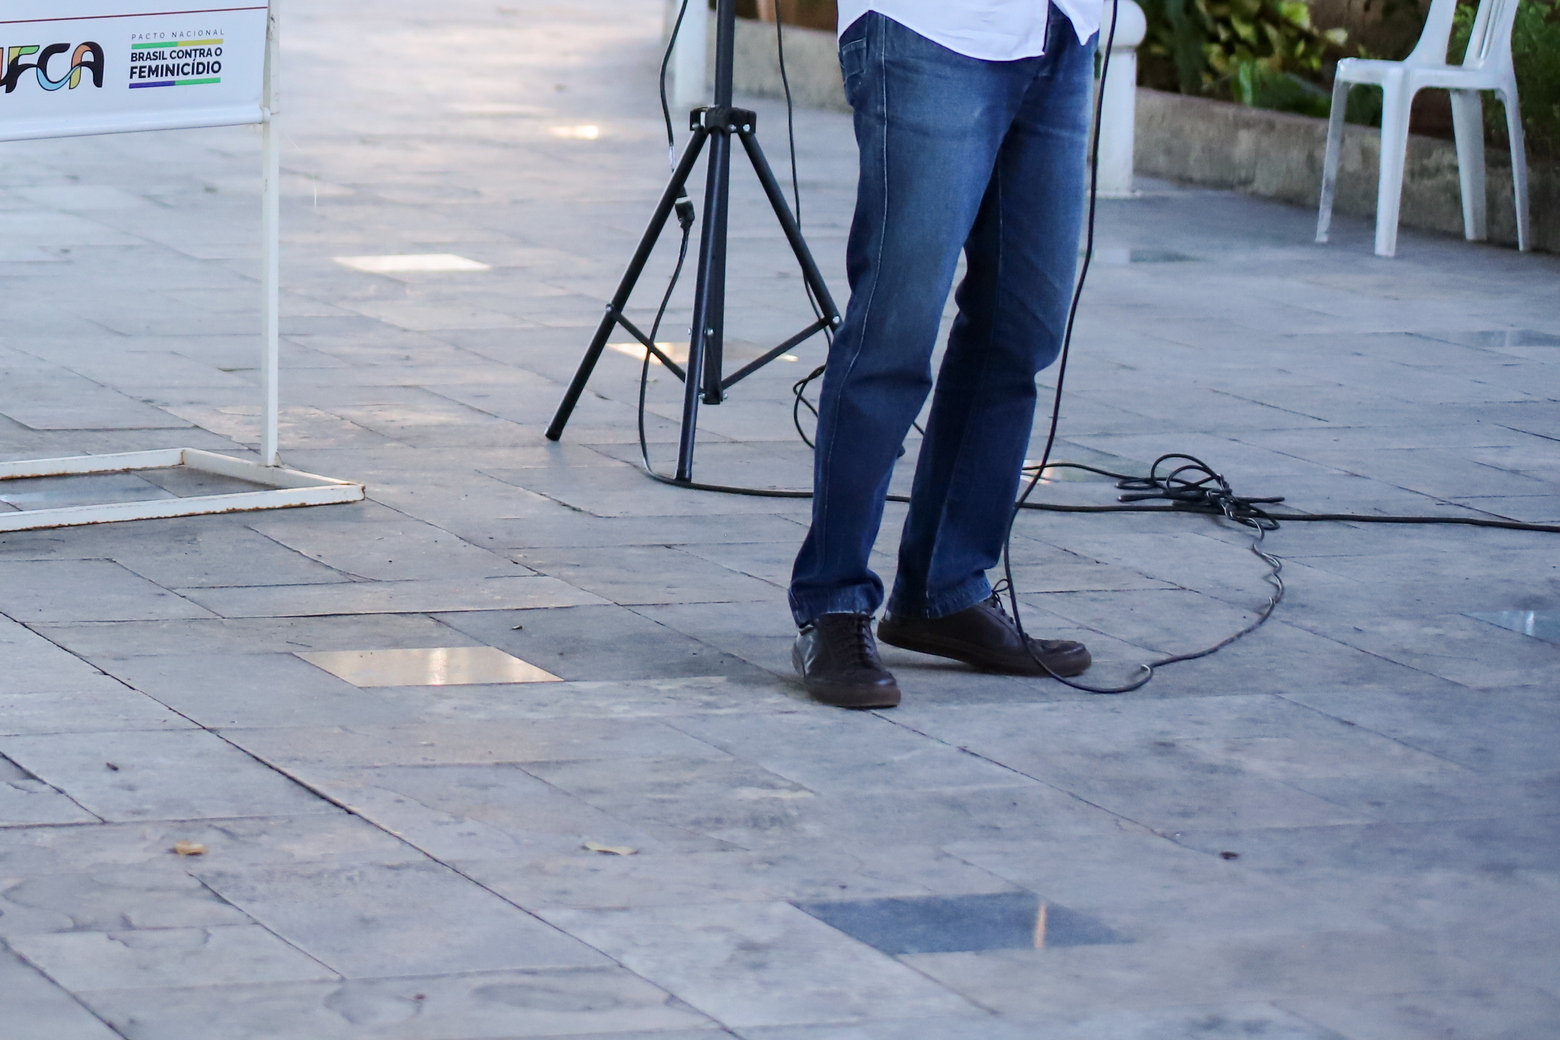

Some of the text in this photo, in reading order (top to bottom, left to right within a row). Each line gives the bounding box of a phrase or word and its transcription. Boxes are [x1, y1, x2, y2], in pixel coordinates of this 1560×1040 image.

[172, 29, 224, 38] NACIONAL
[131, 47, 222, 62] BRASIL CONTRA O
[130, 59, 222, 79] FEMINICÍDIO
